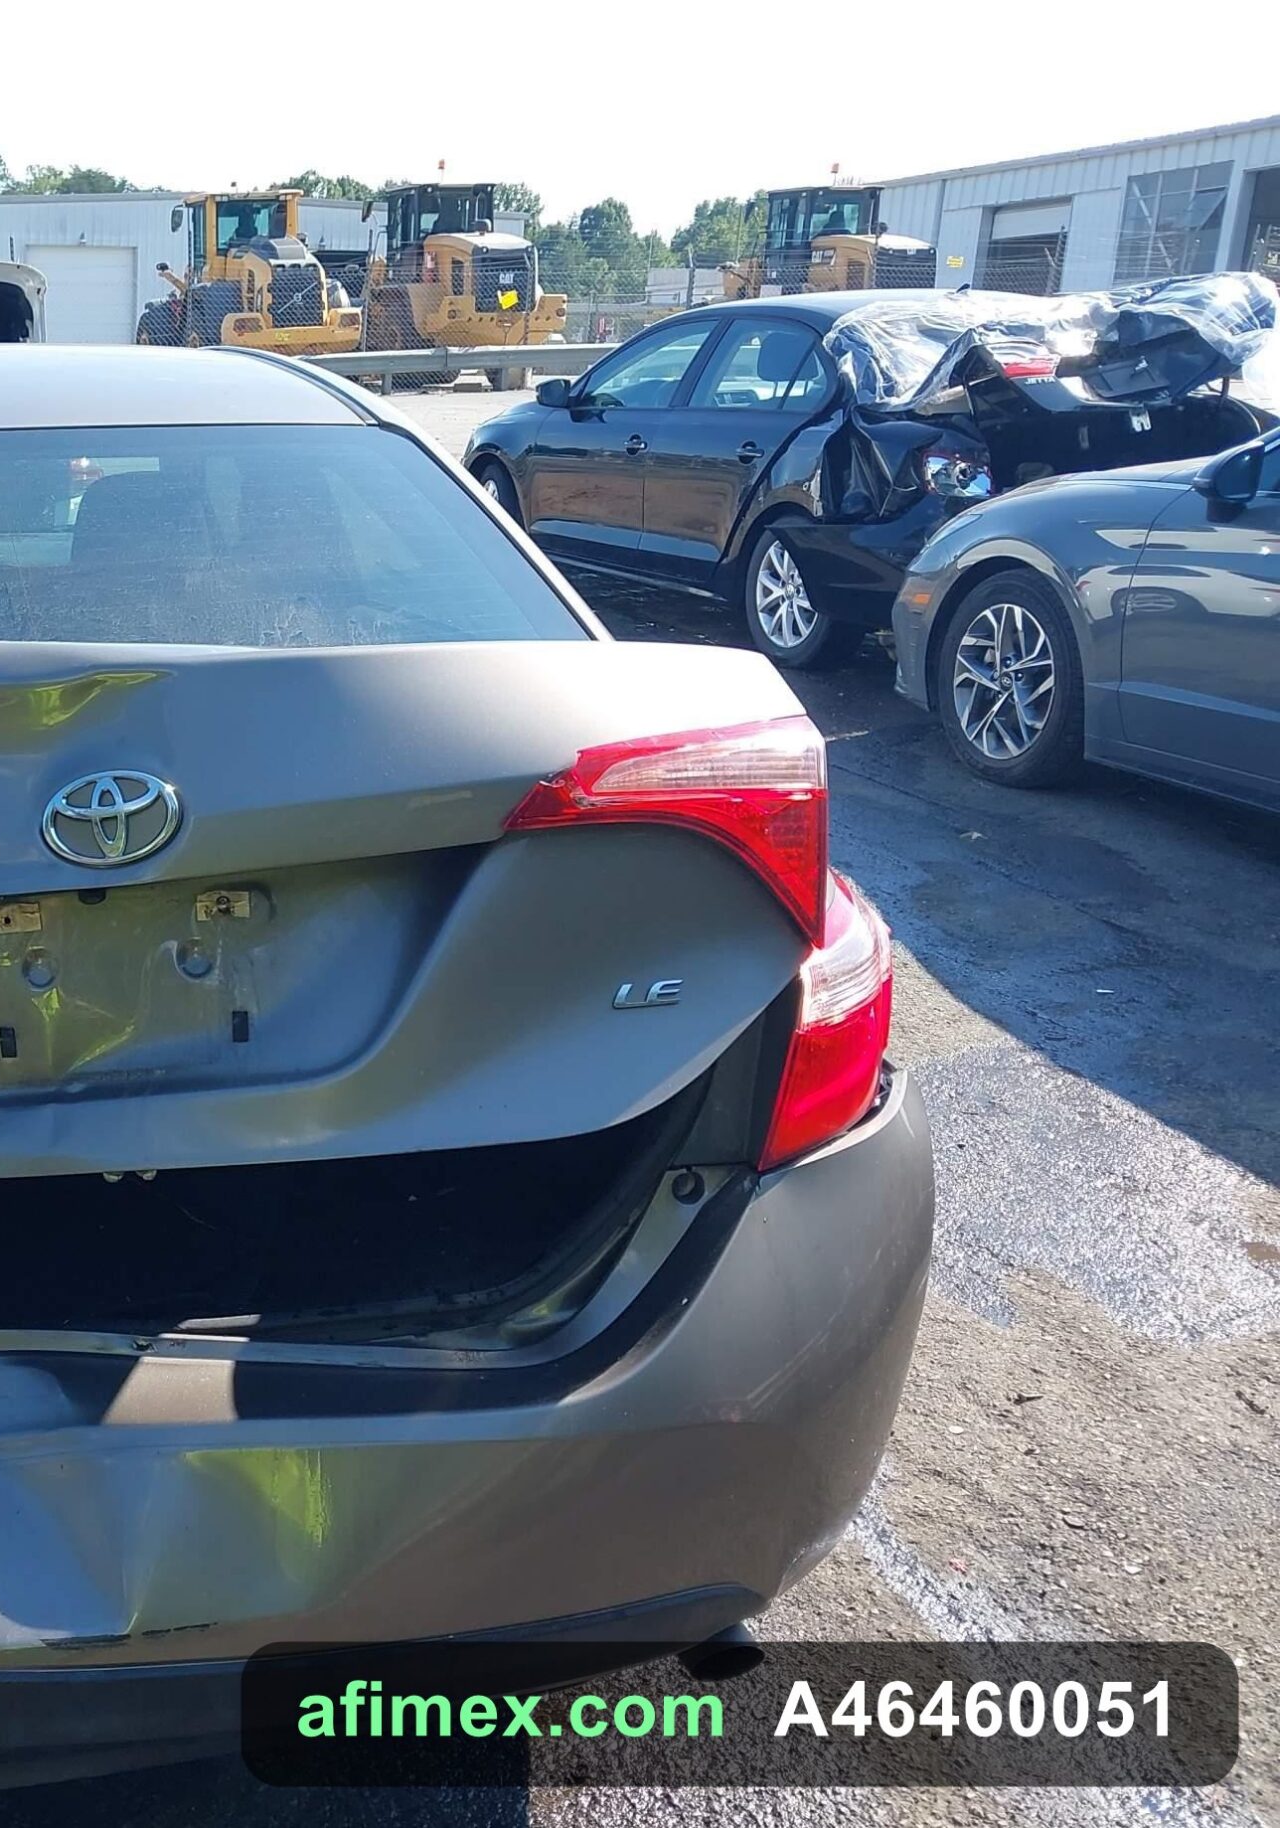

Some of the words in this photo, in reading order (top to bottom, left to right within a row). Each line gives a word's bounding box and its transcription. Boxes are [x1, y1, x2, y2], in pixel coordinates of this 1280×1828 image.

[499, 272, 514, 284] CAT
[1024, 377, 1056, 385] JETTA
[613, 979, 683, 1009] LE
